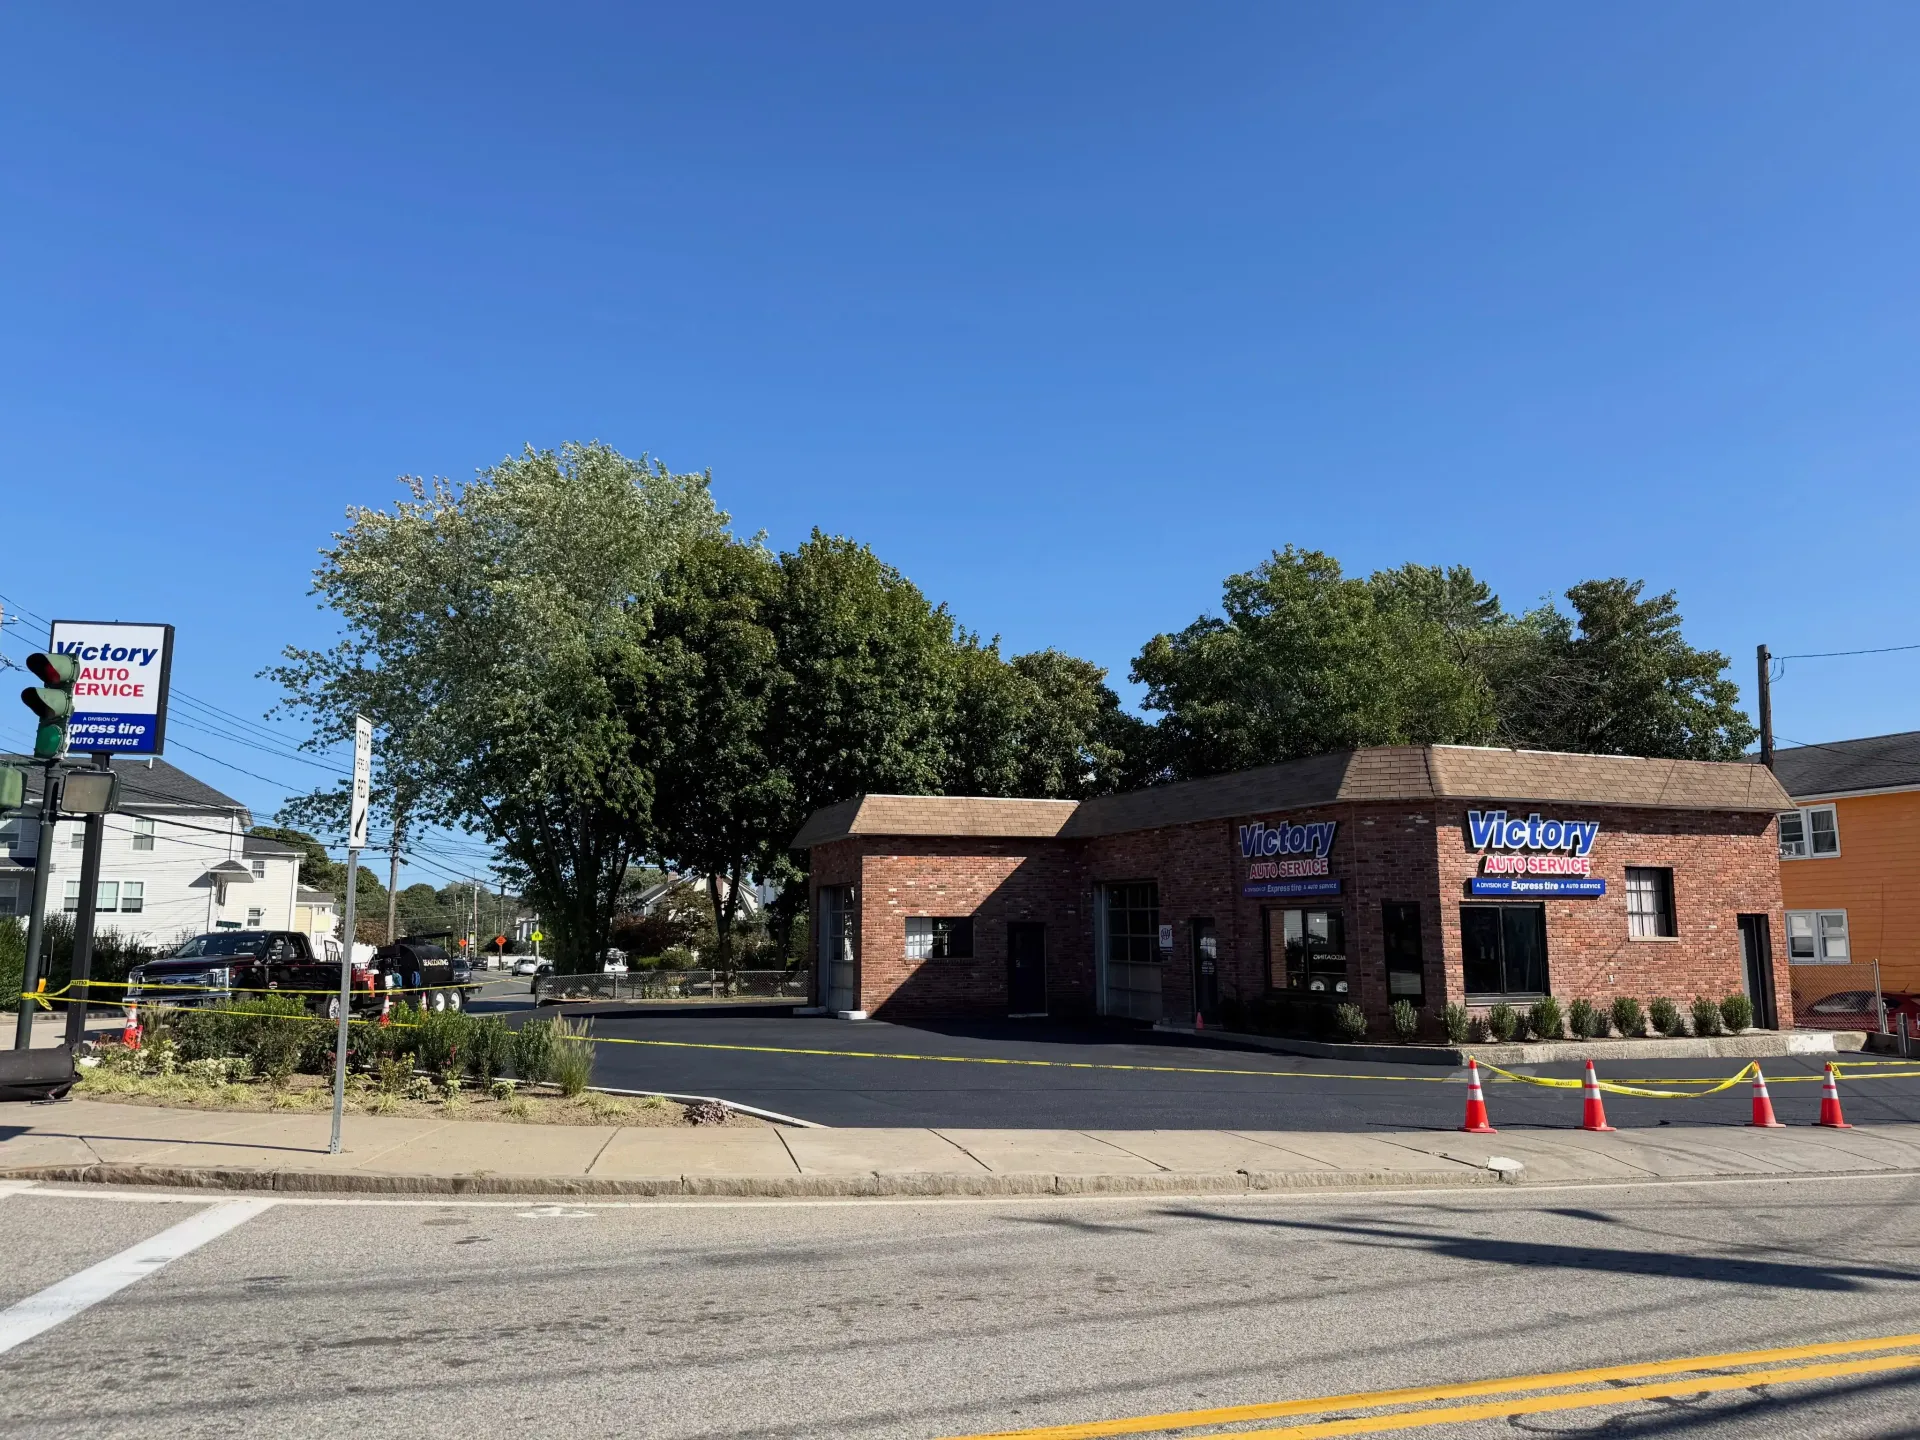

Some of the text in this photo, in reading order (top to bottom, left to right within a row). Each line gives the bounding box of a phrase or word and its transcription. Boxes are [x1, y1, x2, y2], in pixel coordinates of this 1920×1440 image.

[57, 641, 158, 666] Victory
[80, 667, 129, 681] AUTO
[74, 682, 145, 697] ERVICE
[67, 722, 145, 735] xpress tire
[69, 737, 139, 746] AUTO SERVICE
[1239, 820, 1336, 858] Victory
[1468, 810, 1600, 856] Victory
[1250, 858, 1328, 879] AUTO SERVICE
[1484, 856, 1590, 874] AUTO SERVICE
[1267, 884, 1290, 894] Express
[1290, 883, 1302, 892] tire
[1511, 881, 1544, 891] Express
[1544, 881, 1559, 890] tire
